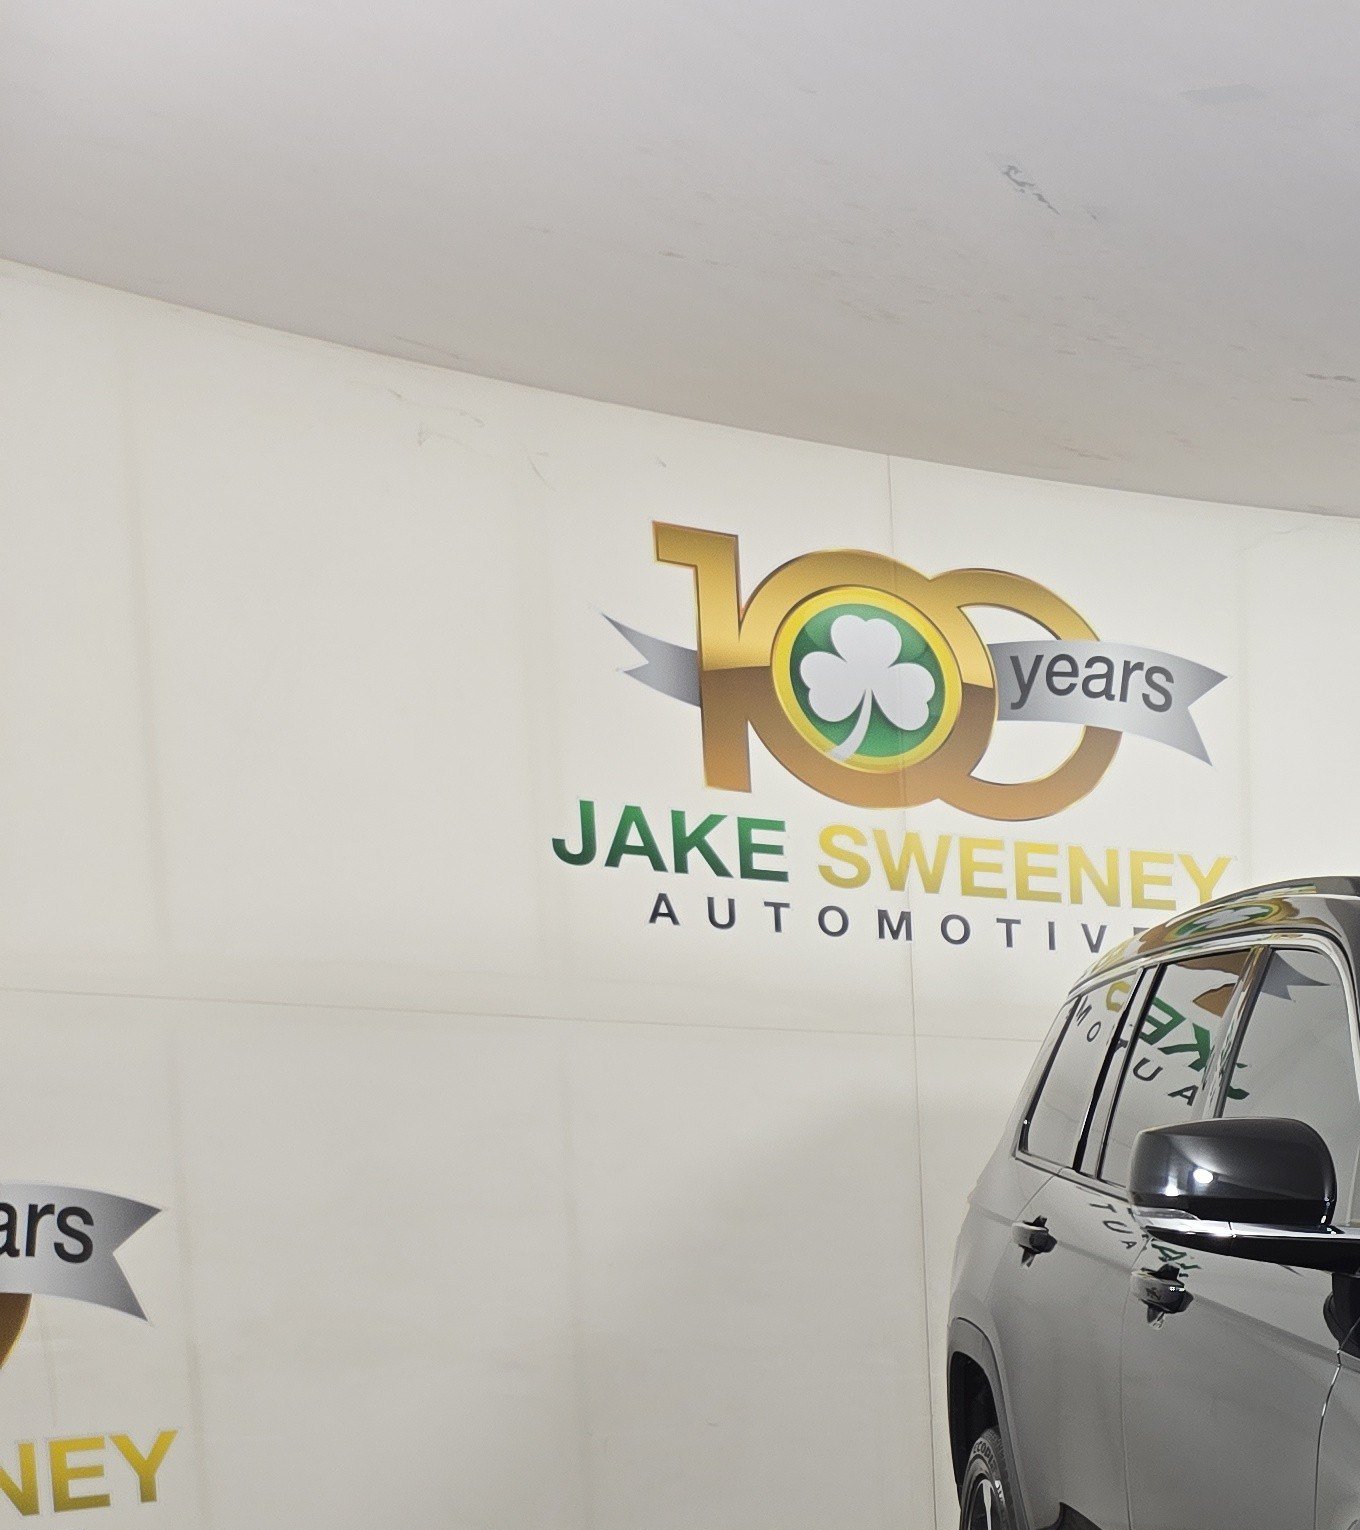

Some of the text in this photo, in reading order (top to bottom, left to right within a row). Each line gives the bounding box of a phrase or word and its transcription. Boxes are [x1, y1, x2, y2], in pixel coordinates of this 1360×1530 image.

[1010, 653, 1176, 714] years
[551, 799, 1232, 911] JAKE SWEENEY
[648, 891, 1148, 954] AUTOMOTIV
